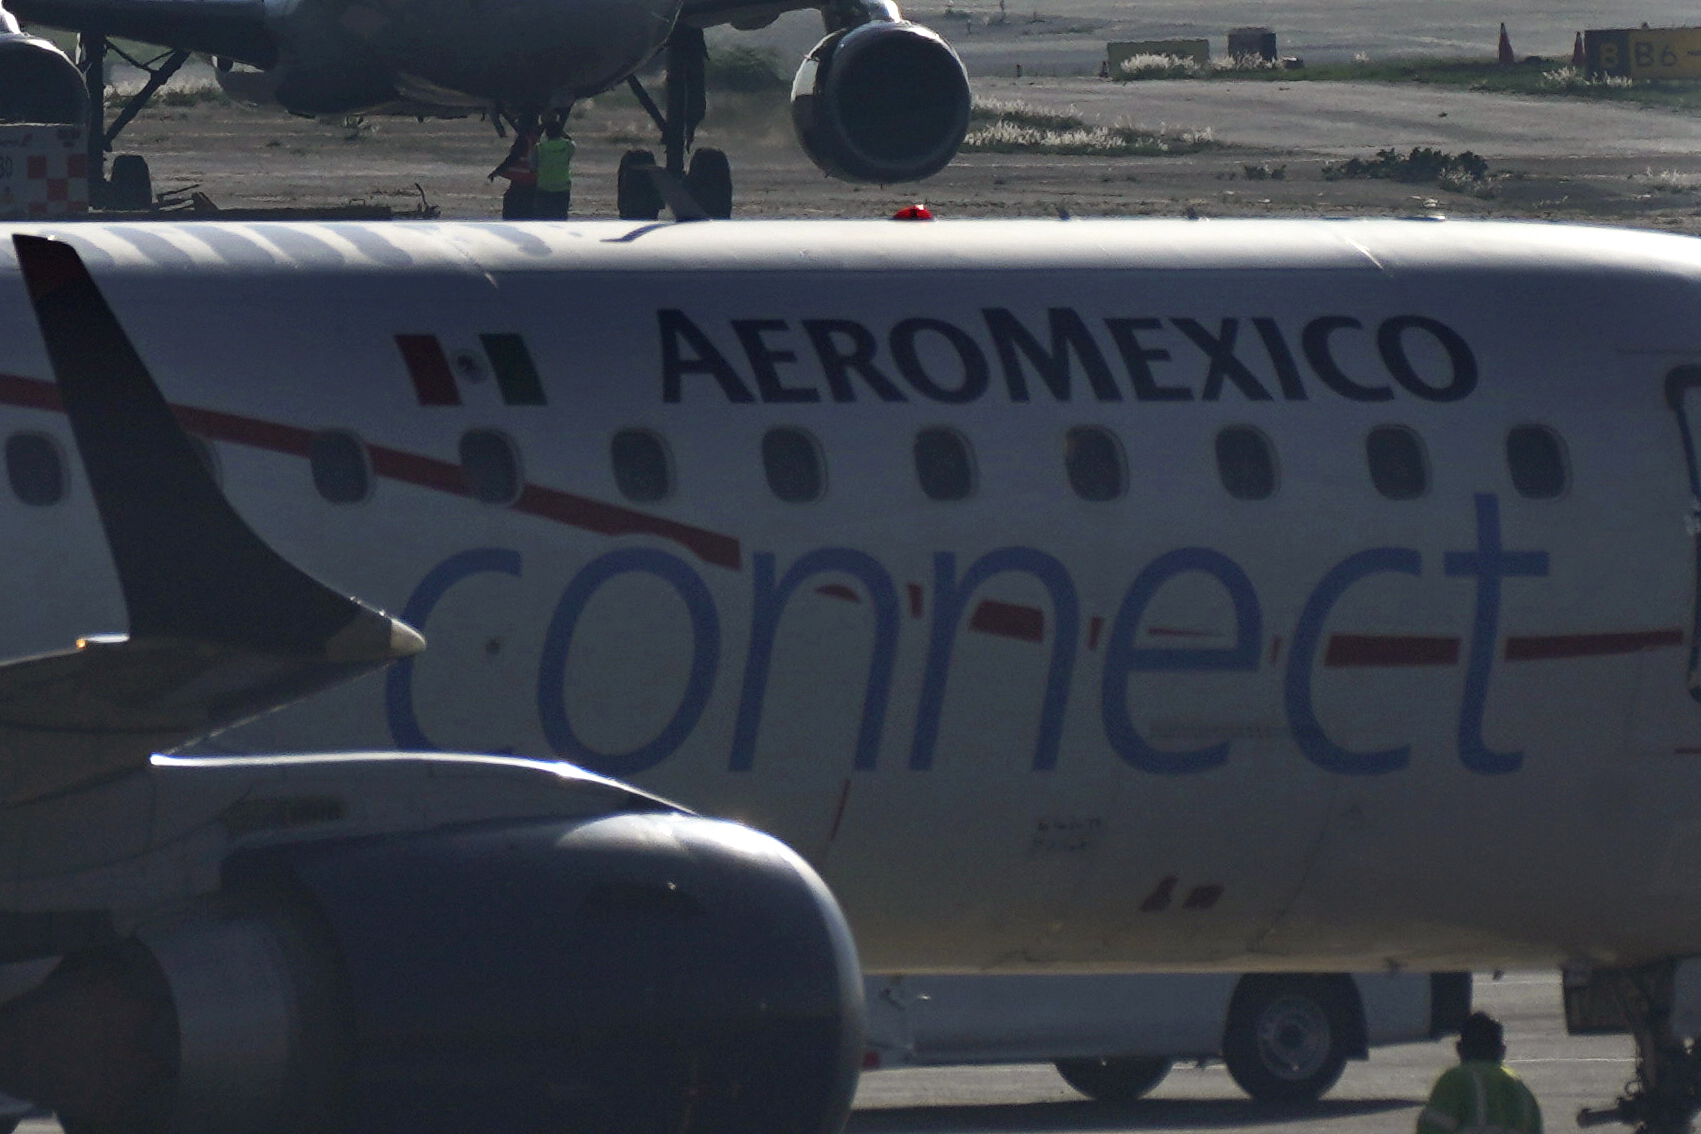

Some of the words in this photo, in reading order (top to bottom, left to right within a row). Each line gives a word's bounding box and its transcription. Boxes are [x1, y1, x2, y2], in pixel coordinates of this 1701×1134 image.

[1635, 42, 1678, 66] B6
[656, 306, 1479, 404] AEROMEXICO
[384, 492, 1549, 778] connect
